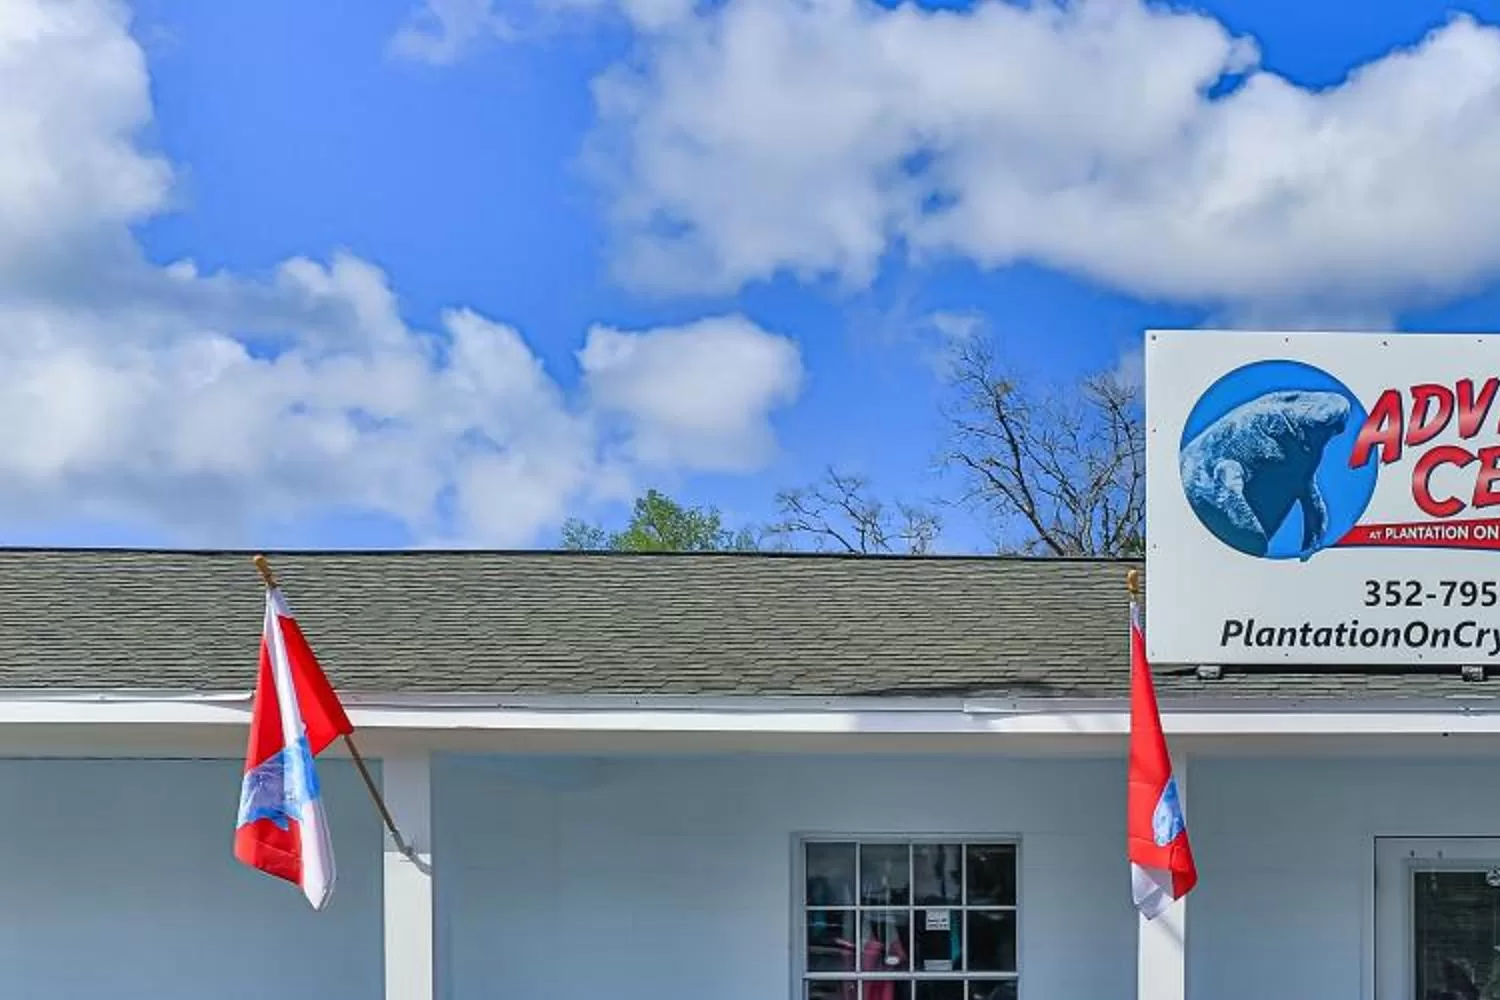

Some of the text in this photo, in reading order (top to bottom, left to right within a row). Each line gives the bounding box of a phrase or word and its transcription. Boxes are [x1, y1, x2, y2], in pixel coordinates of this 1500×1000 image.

[1369, 531, 1382, 539] AT
[1385, 525, 1469, 540] PLANTATION
[1473, 526, 1499, 540] ON
